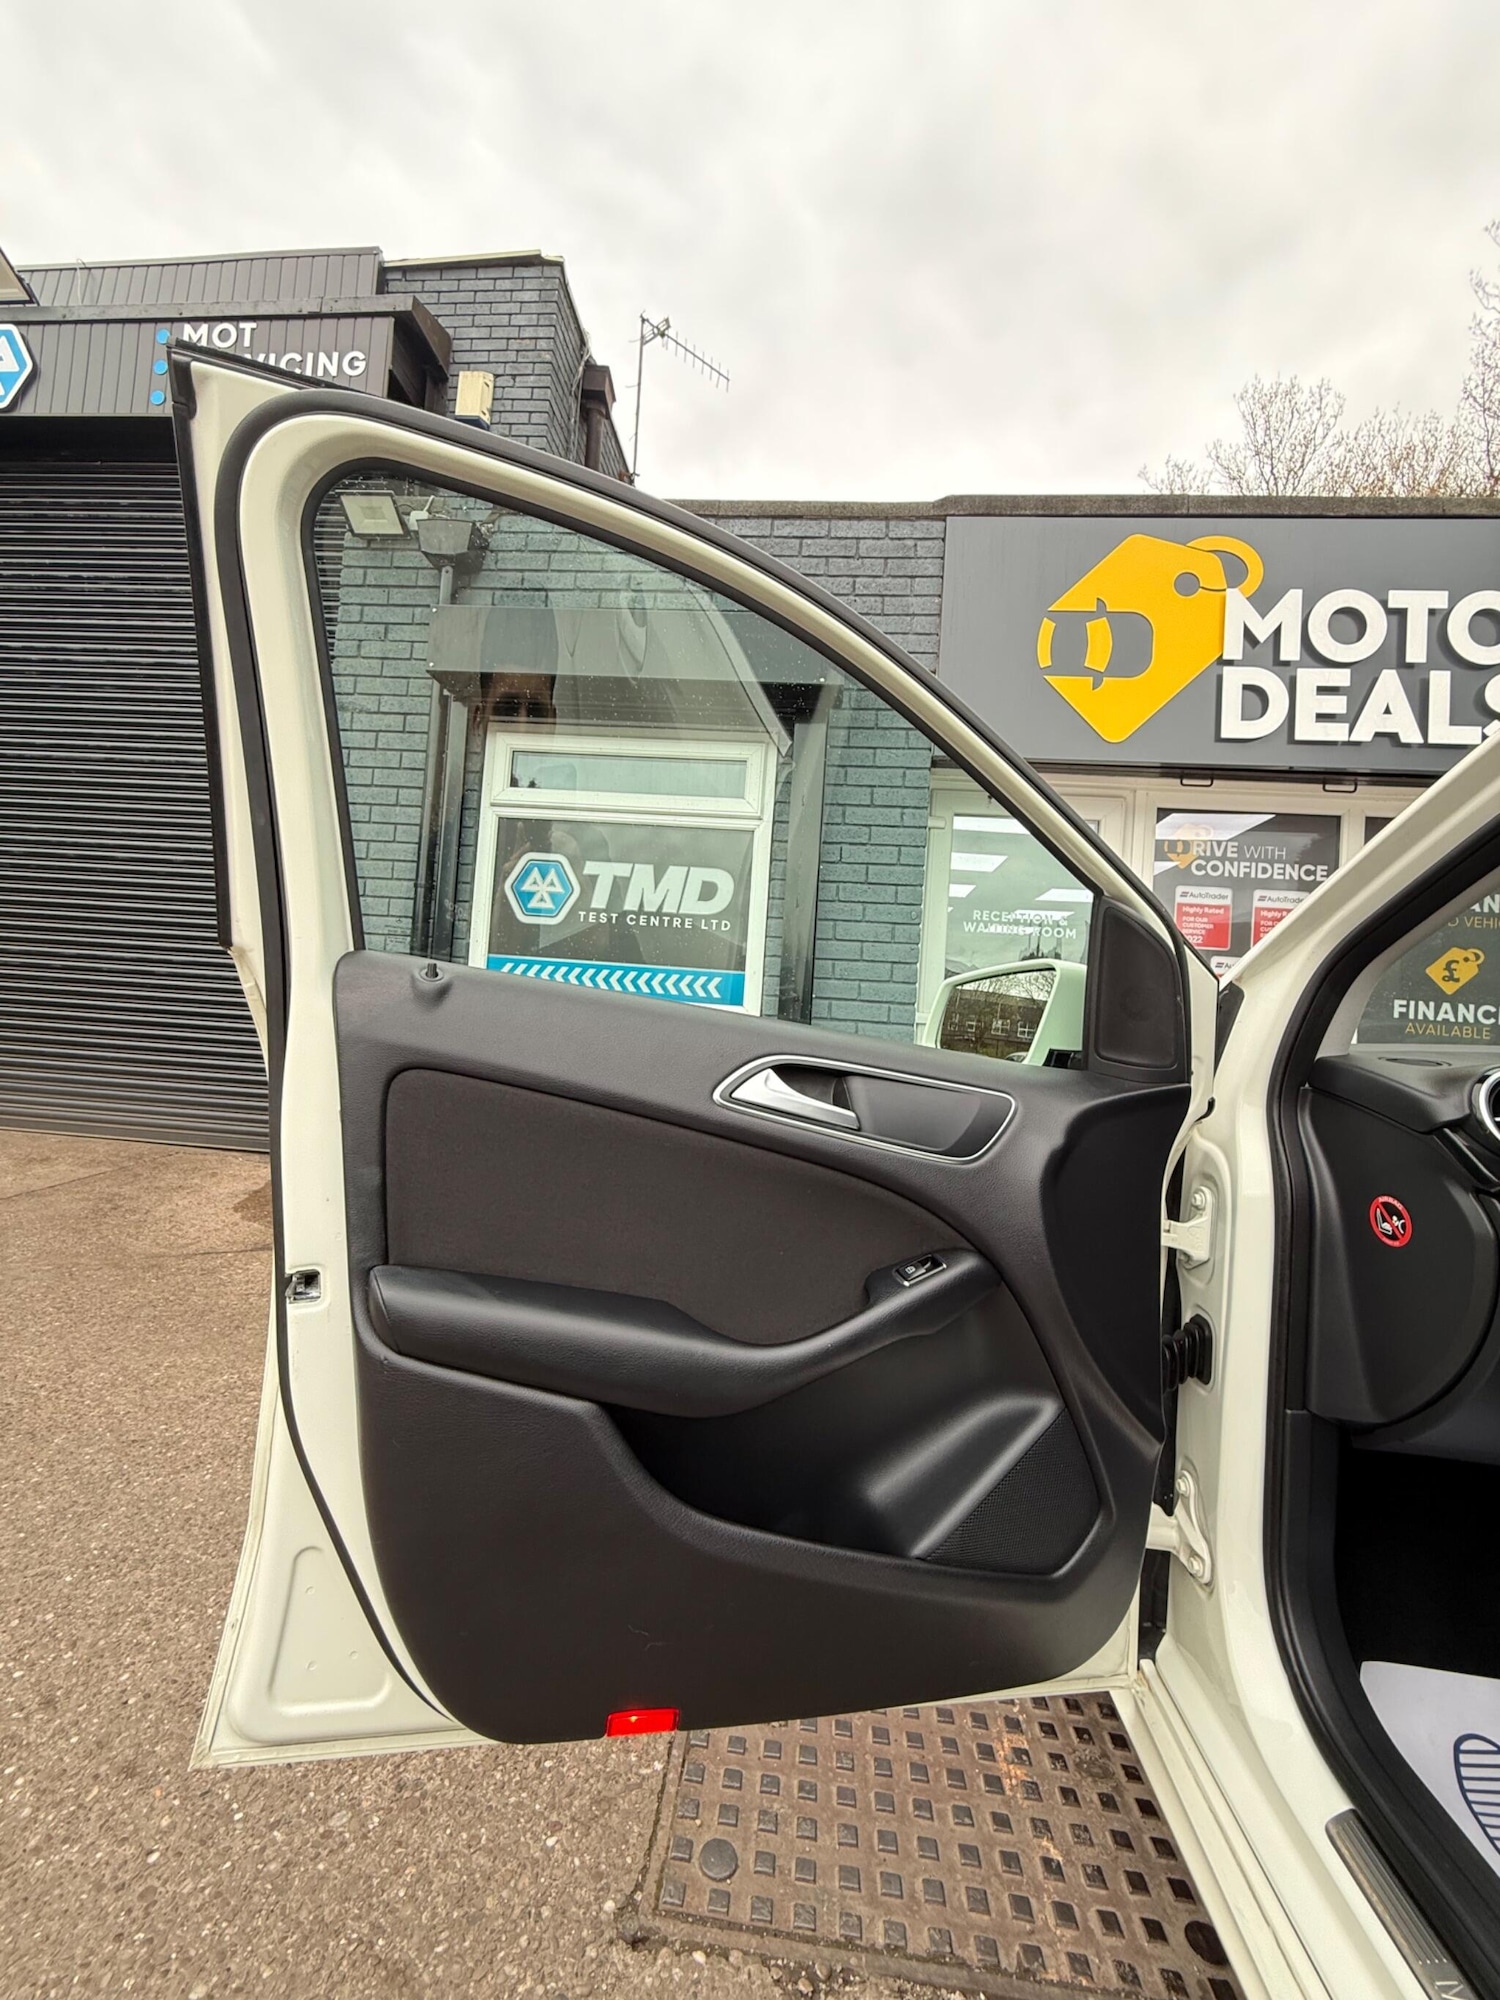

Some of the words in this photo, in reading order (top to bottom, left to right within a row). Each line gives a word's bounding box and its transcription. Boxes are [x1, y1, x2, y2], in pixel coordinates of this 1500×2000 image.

[183, 323, 257, 349] MOT
[1244, 845, 1286, 860] WITH
[1191, 859, 1329, 881] CONFIDENCE
[582, 860, 735, 915] TMD
[1189, 891, 1229, 900] AutoTrader
[973, 910, 1053, 926] RECEPTION
[1182, 906, 1203, 915] Highly
[578, 911, 619, 924] TEST
[626, 914, 693, 929] CENTRE
[701, 919, 731, 932] LTD
[1464, 916, 1500, 929] VEHI
[1032, 926, 1077, 939] ROOM
[1393, 999, 1500, 1025] FINANC
[1405, 1022, 1491, 1040] AVAILABLE
